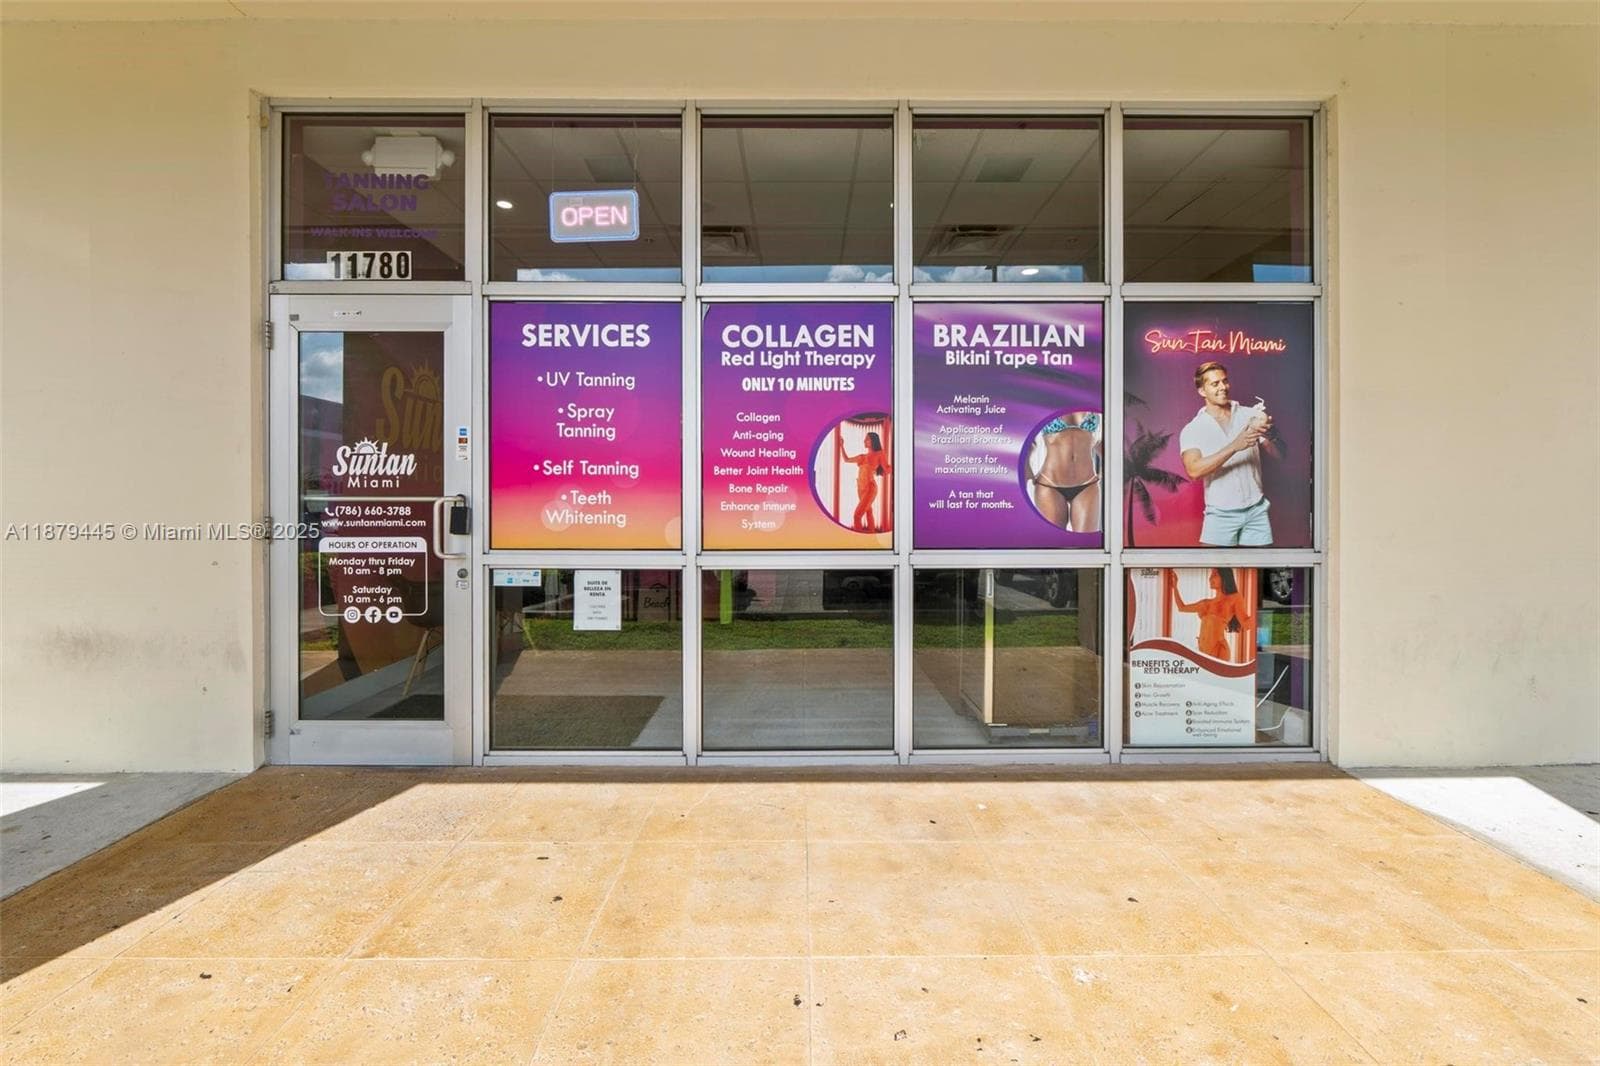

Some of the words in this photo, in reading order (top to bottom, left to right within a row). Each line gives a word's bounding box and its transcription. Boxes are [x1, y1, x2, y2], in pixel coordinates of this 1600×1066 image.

[323, 173, 430, 190] TANNING
[333, 194, 417, 211] SALON
[561, 205, 628, 227] OPEN
[376, 228, 438, 238] WELCOME
[331, 252, 410, 279] 11780
[521, 323, 651, 348] SERVICES
[721, 324, 875, 348] COLLAGEN
[933, 324, 1085, 347] BRAZILIAN
[1144, 329, 1186, 353] Sun
[1187, 330, 1226, 353] Tan
[1229, 331, 1286, 354] Miami
[721, 351, 754, 367] Red
[760, 351, 801, 369] Light
[804, 351, 876, 369] Therapy
[945, 350, 990, 366] Bikini
[995, 351, 1038, 368] Tape
[1042, 351, 1073, 366] Tan
[546, 372, 570, 387] UV
[576, 372, 636, 390] Tanning
[742, 377, 775, 392] ONLY
[778, 377, 794, 392] 10
[797, 377, 855, 392] MINUTES
[953, 395, 990, 404] Melanin
[567, 403, 615, 421] Spray
[936, 404, 982, 416] Activating
[984, 405, 1007, 414] Juice
[736, 412, 781, 424] Collagen
[556, 423, 616, 441] Tanning
[732, 430, 784, 442] Anti-aging
[939, 425, 991, 437] Application
[993, 424, 1003, 433] of
[931, 435, 971, 444] Brazilian
[332, 442, 417, 477] Suntan
[720, 448, 755, 458] Wound
[759, 448, 797, 460] Healing
[945, 455, 982, 464] Boosters
[985, 455, 998, 464] for
[543, 460, 574, 475] Self
[580, 461, 640, 479] Tanning
[713, 466, 743, 476] Better
[746, 466, 768, 476] Joint
[771, 466, 804, 476] Health
[935, 465, 978, 474] maximum
[980, 465, 1008, 474] results
[347, 477, 400, 488] Miami
[729, 484, 753, 494] Bone
[756, 484, 788, 496] Repair
[949, 490, 956, 498] A
[976, 490, 994, 498] that
[571, 490, 612, 505] Teeth
[720, 502, 761, 511] Enhance
[929, 500, 944, 509] will
[947, 500, 963, 509] last
[965, 500, 979, 509] for
[981, 500, 1014, 509] months.
[335, 506, 362, 517] (786)
[364, 506, 412, 516] 660-3788
[321, 518, 426, 527] www.suntanmiami.com
[546, 510, 627, 528] Whitening
[742, 519, 776, 530] System
[329, 541, 356, 549] HOURS
[358, 541, 370, 549] OF
[371, 541, 418, 549] OPERATION
[329, 557, 366, 567] Monday
[368, 557, 386, 566] thru
[388, 557, 416, 567] Friday
[343, 567, 354, 575] 10
[379, 567, 385, 575] 8
[387, 568, 402, 577] pm
[352, 586, 392, 595] Saturday
[343, 595, 354, 603] 10
[379, 595, 385, 603] 6
[387, 596, 402, 605] pm
[1131, 660, 1170, 668] BENEFITS
